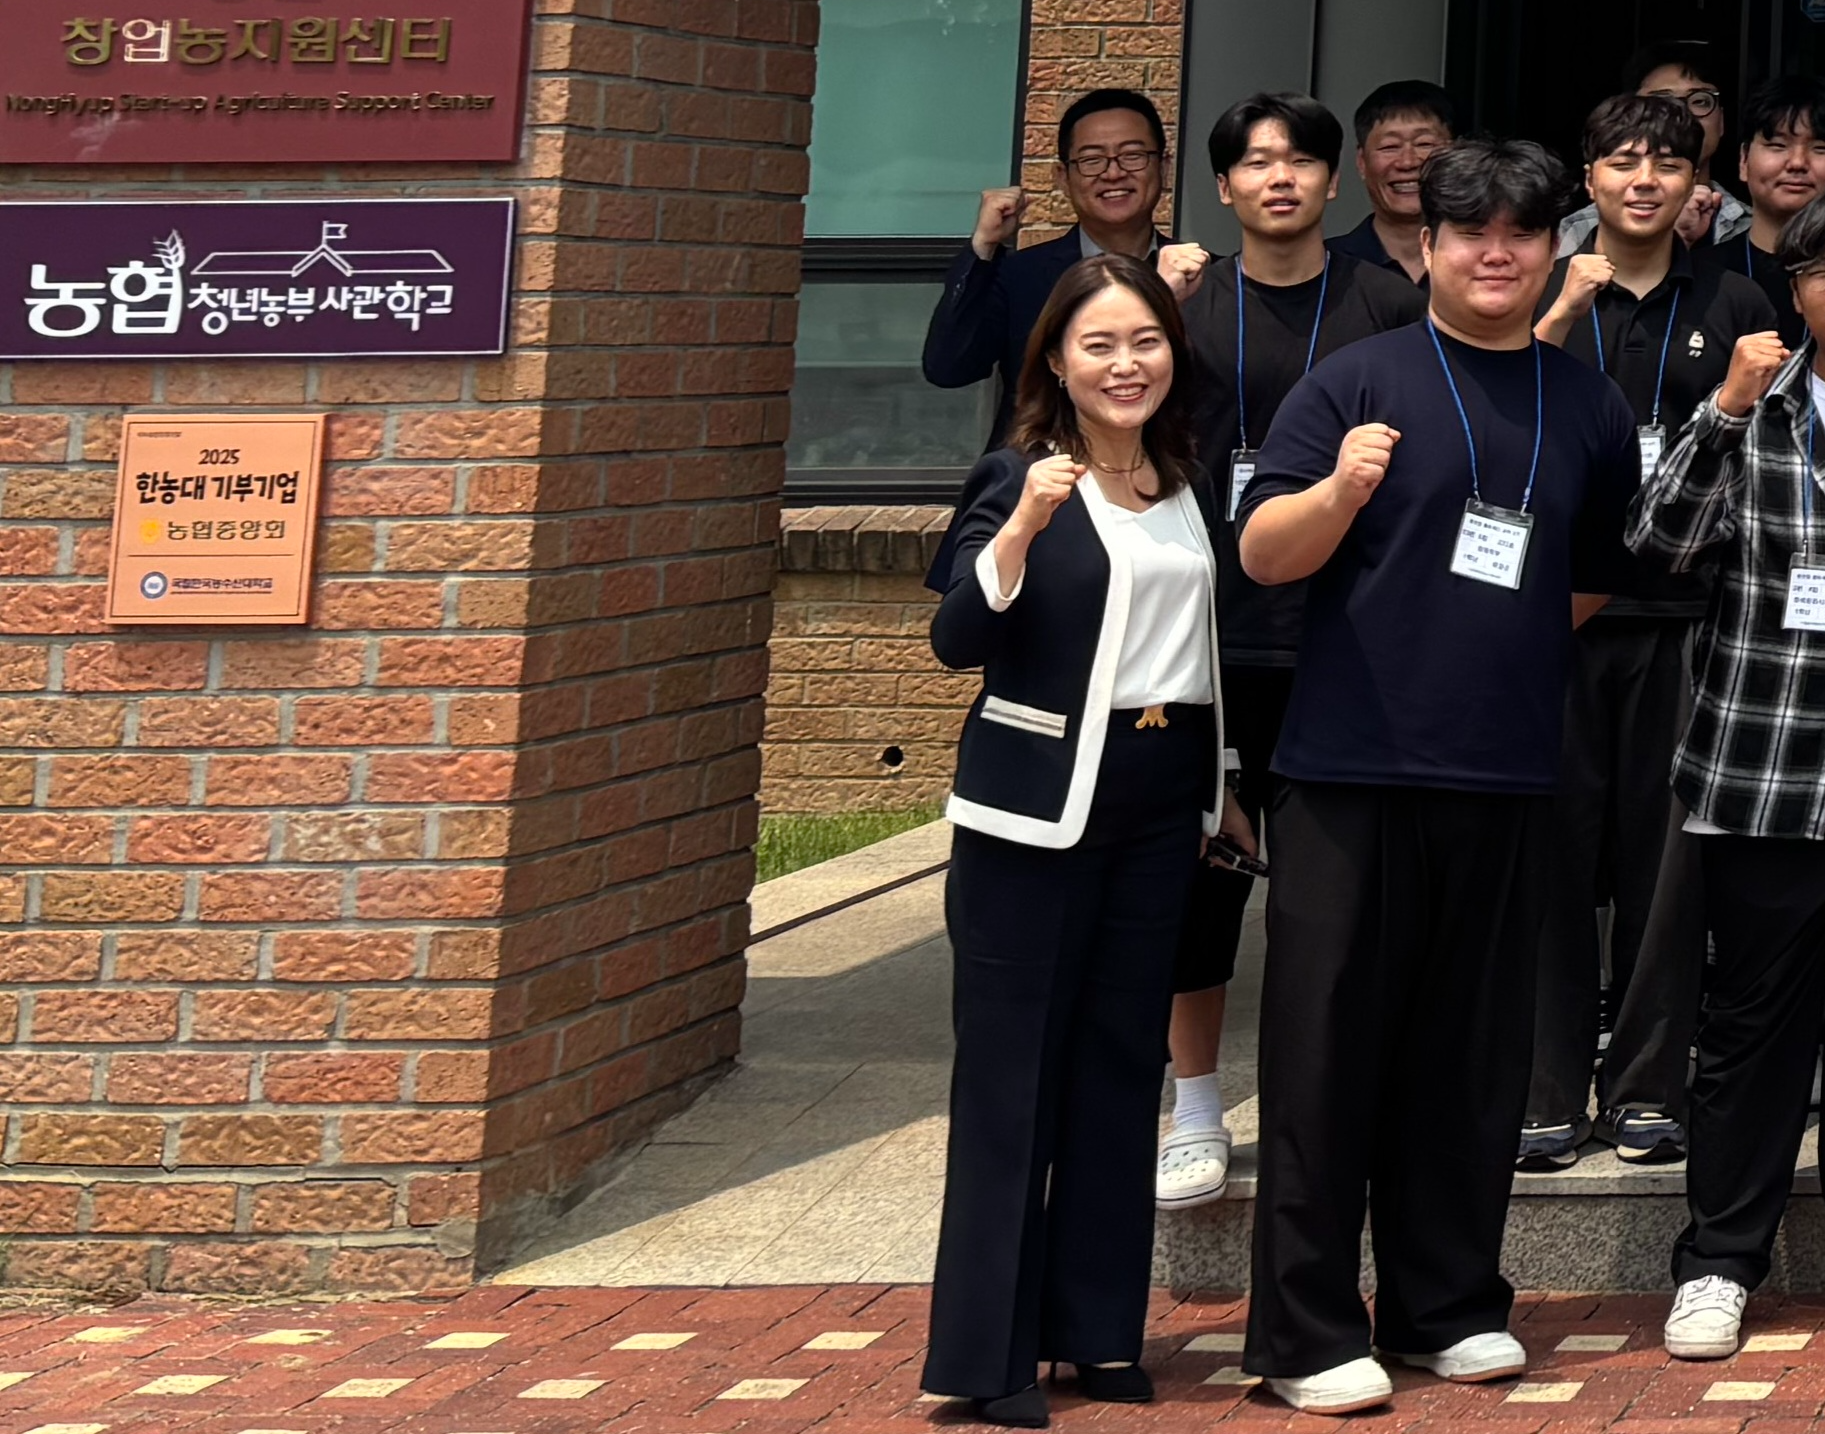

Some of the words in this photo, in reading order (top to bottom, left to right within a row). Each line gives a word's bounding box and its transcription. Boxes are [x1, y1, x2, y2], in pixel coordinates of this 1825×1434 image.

[59, 16, 453, 66] 창업농지원센터
[6, 93, 116, 116] NongHyup
[119, 93, 208, 115] Start-up
[213, 91, 331, 115] Agriculture
[333, 90, 421, 113] Support
[426, 90, 496, 111] Center
[23, 258, 186, 338] 농협
[186, 282, 315, 336] 청년농부
[198, 448, 241, 466] 2025
[135, 470, 208, 505] 한농대
[210, 470, 300, 505] 기부기업
[166, 519, 286, 542] 농협중앙회
